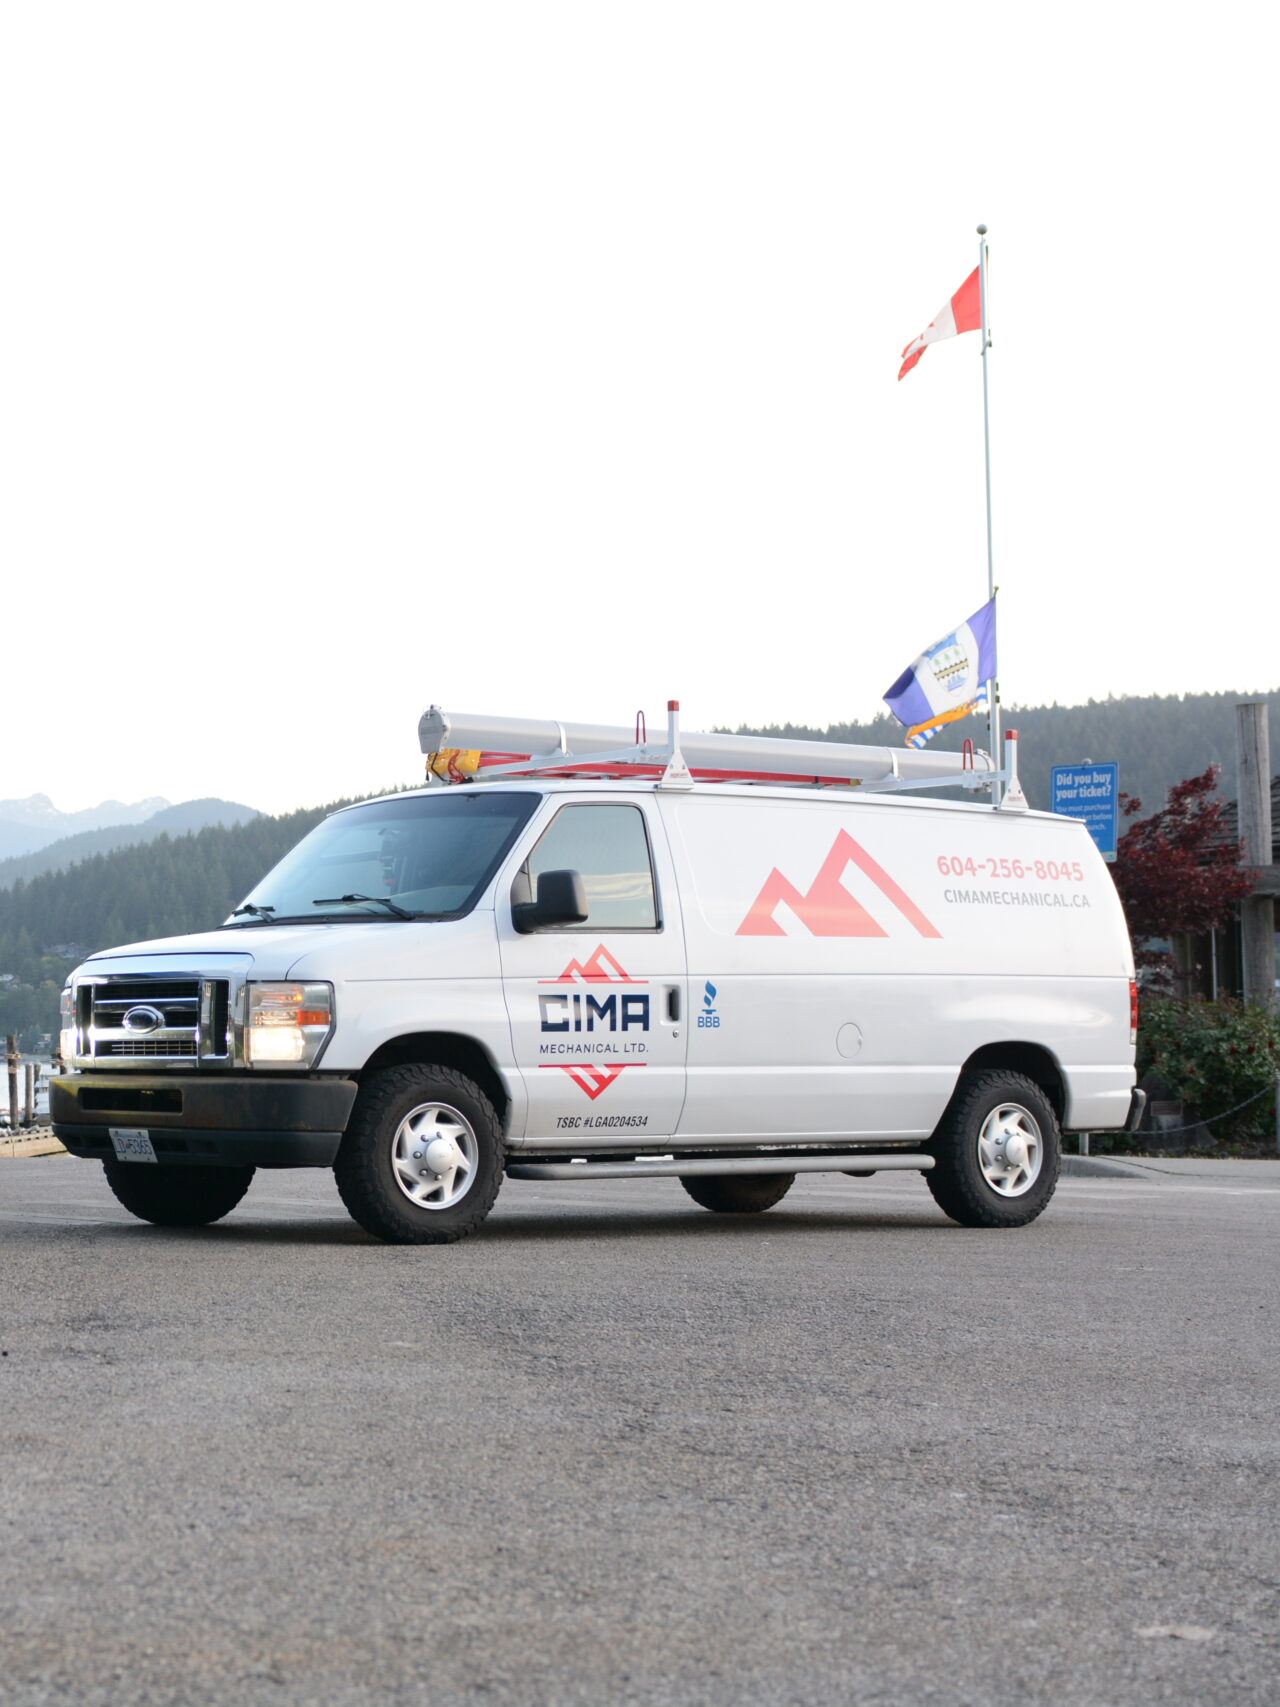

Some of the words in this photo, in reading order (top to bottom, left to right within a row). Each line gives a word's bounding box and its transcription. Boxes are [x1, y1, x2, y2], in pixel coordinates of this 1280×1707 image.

[1056, 773, 1073, 786] Did
[1074, 775, 1091, 787] you
[1093, 771, 1111, 786] buy
[1056, 789, 1078, 802] your
[1079, 784, 1111, 798] ticket?
[937, 855, 1084, 882] 604-256-8045
[943, 889, 1091, 908] CIMAMECHANICAL.CA
[538, 994, 650, 1032] CIMA
[697, 1016, 720, 1028] BBB
[539, 1043, 619, 1054] MECHANICAL
[624, 1043, 649, 1053] LTD.
[556, 1117, 581, 1129] TSBC
[583, 1116, 649, 1128] #LGA0204534
